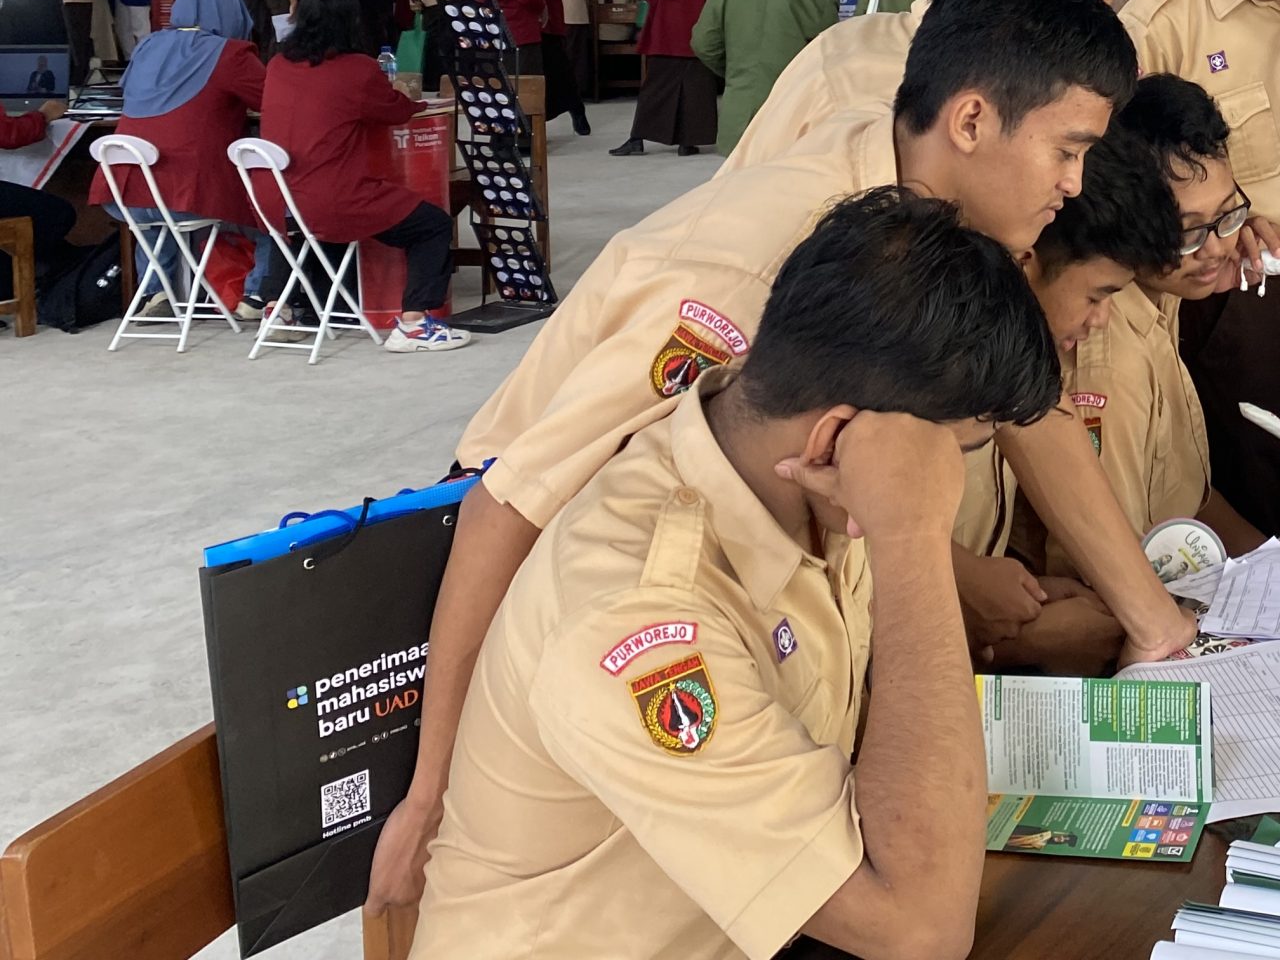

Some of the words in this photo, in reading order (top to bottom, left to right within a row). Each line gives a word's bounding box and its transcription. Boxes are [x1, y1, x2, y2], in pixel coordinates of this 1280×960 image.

[686, 304, 744, 349] PURWOREJO
[609, 625, 688, 668] PURWOREJO
[632, 673, 661, 693] JAWA
[664, 655, 702, 678] TENGAH
[318, 706, 370, 738] baru
[374, 689, 419, 718] UAD
[322, 821, 352, 839] Hotline
[352, 815, 372, 829] pmb
